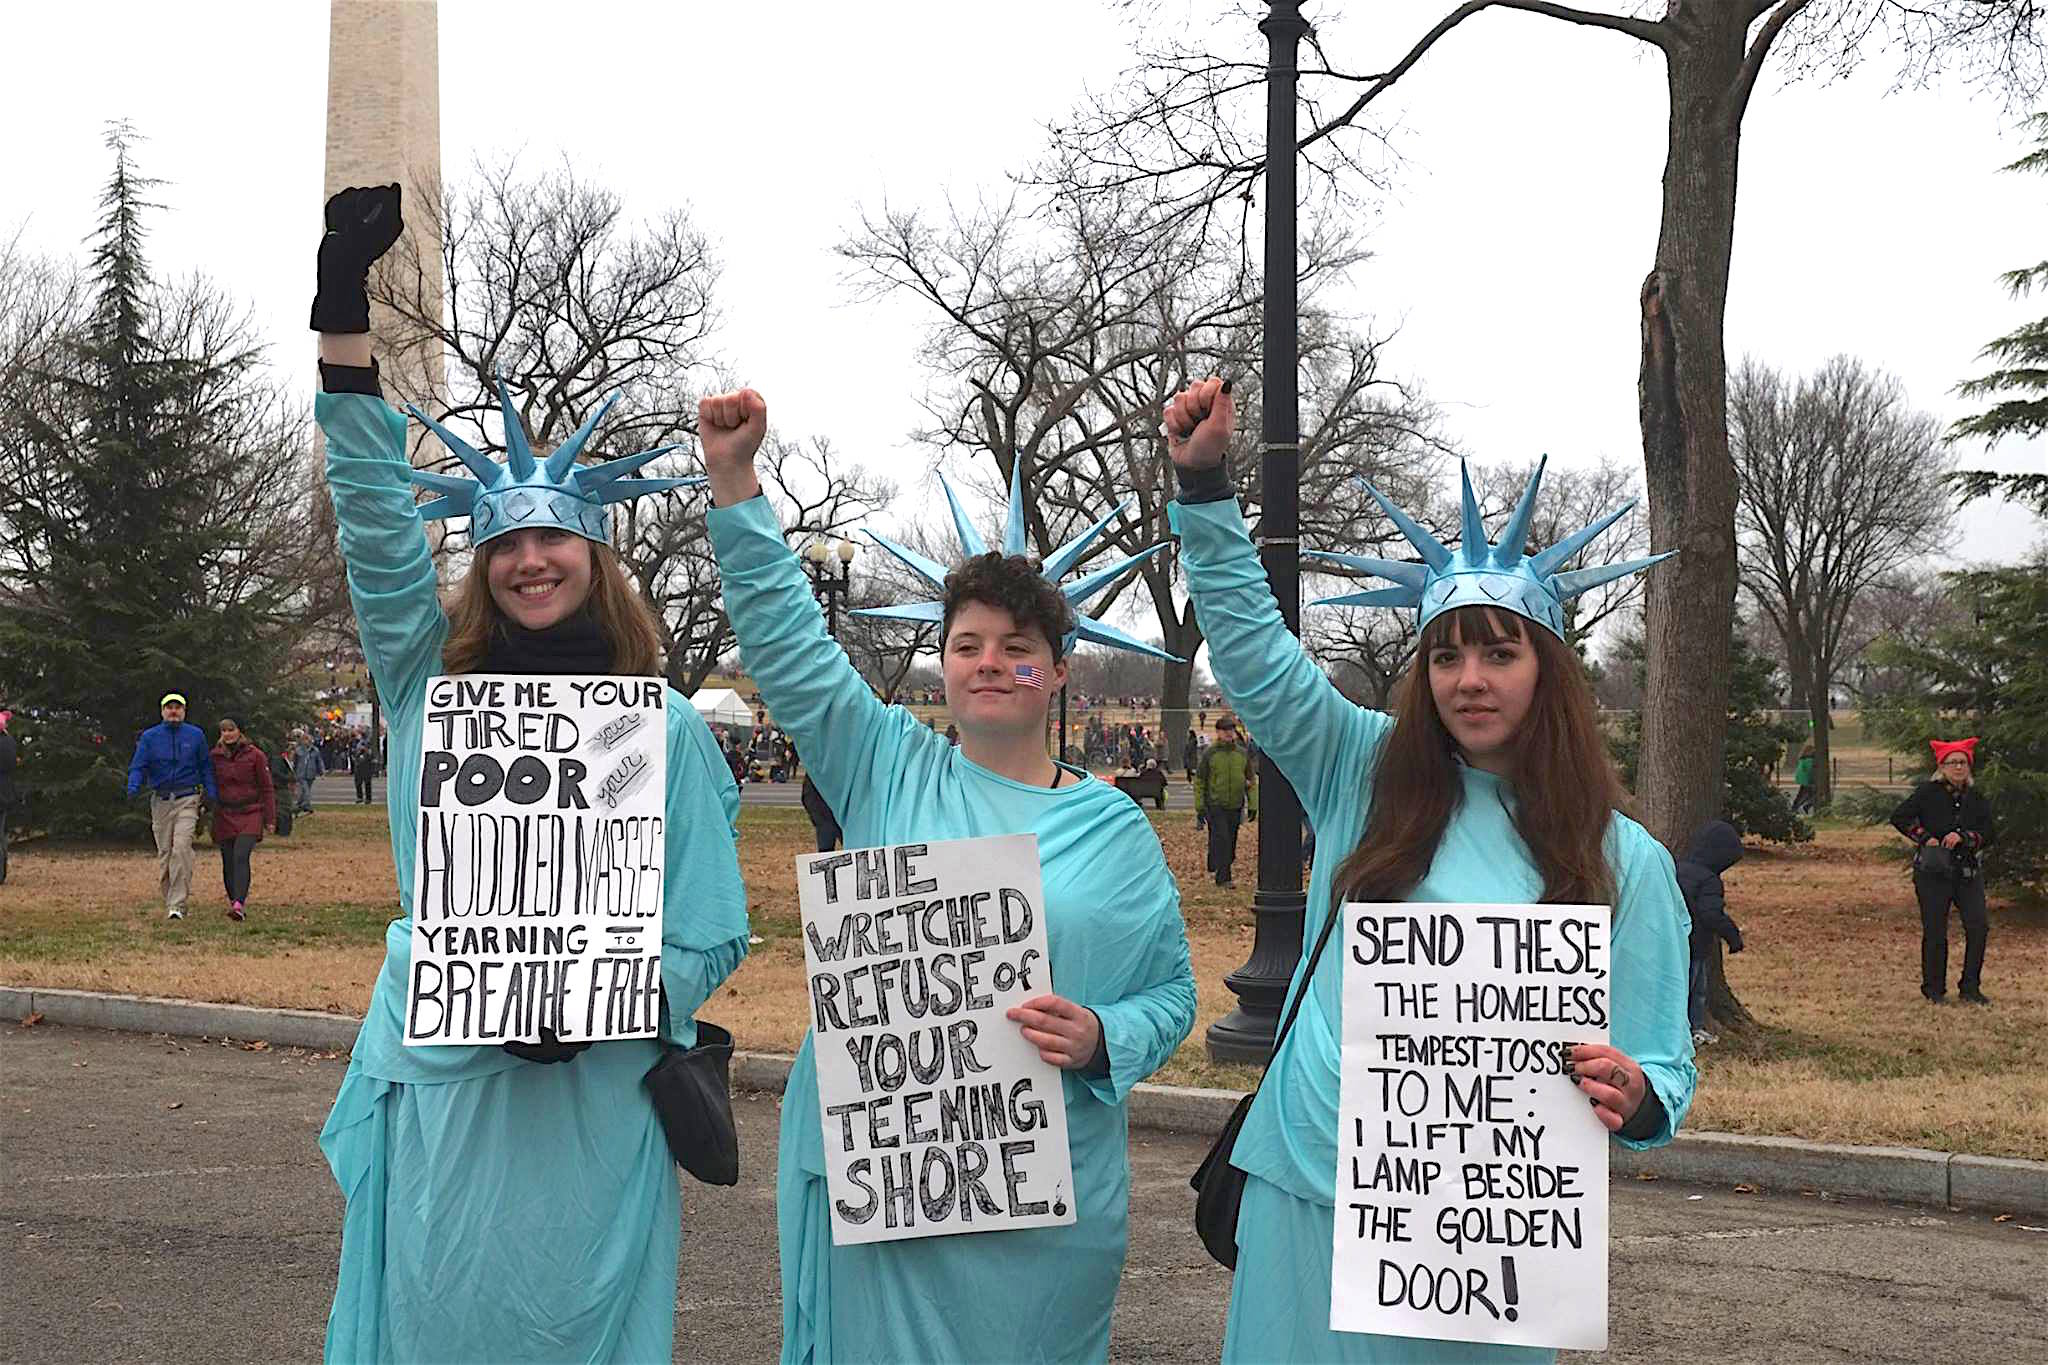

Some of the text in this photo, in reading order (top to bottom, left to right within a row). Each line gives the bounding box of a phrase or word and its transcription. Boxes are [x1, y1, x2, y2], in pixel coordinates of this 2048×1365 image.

[431, 680, 662, 709] GIVE ME YOUR
[428, 709, 580, 753] TIRED
[420, 751, 590, 809] POOR
[421, 811, 662, 920] HUDDLED MASSES
[810, 844, 937, 904] THE
[417, 925, 635, 954] YEARNING TO
[806, 888, 1033, 962] WRETCHED
[1353, 915, 1607, 979] SEND THESE,
[409, 955, 660, 1039] BREATHE FREE
[811, 949, 1039, 1032] REFUSE of
[1375, 982, 1608, 1029] THE HOMELESS,
[846, 1019, 992, 1093] YOUR
[1376, 1034, 1588, 1075] TEMPEST-TOSSE
[826, 1078, 1048, 1152] TEEMING
[1368, 1068, 1428, 1117] TO
[1355, 1118, 1545, 1160] I LIFT MY
[1352, 1153, 1584, 1199] LAMP BESIDE
[1349, 1203, 1582, 1255] THE GOLDEN
[1378, 1255, 1520, 1323] DOOR!
